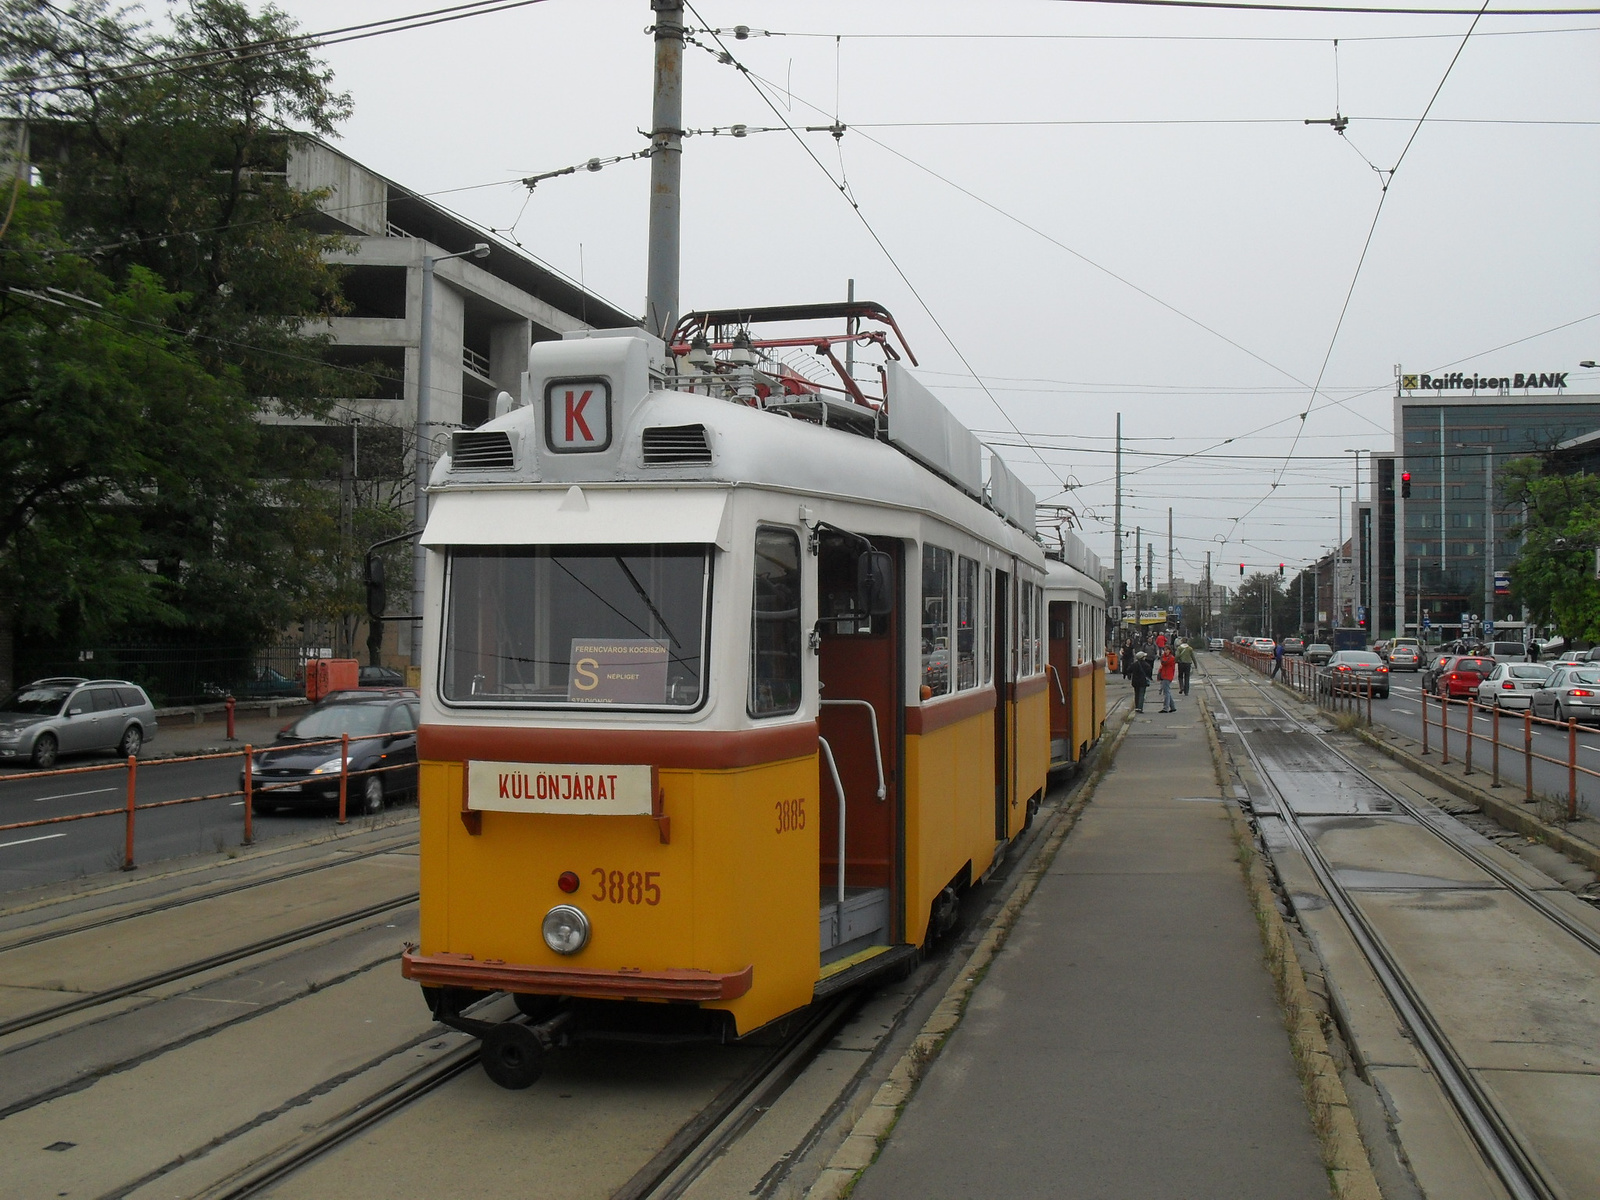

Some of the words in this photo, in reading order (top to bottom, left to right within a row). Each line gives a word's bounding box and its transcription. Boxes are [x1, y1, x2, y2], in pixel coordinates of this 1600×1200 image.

[1420, 372, 1509, 389] Raiffeisen
[1513, 372, 1568, 388] BANK
[565, 390, 595, 441] K
[574, 657, 599, 691] S
[499, 771, 618, 800] KÜLÖNJÁRAT
[774, 797, 806, 835] 3885
[591, 867, 661, 906] 3885
